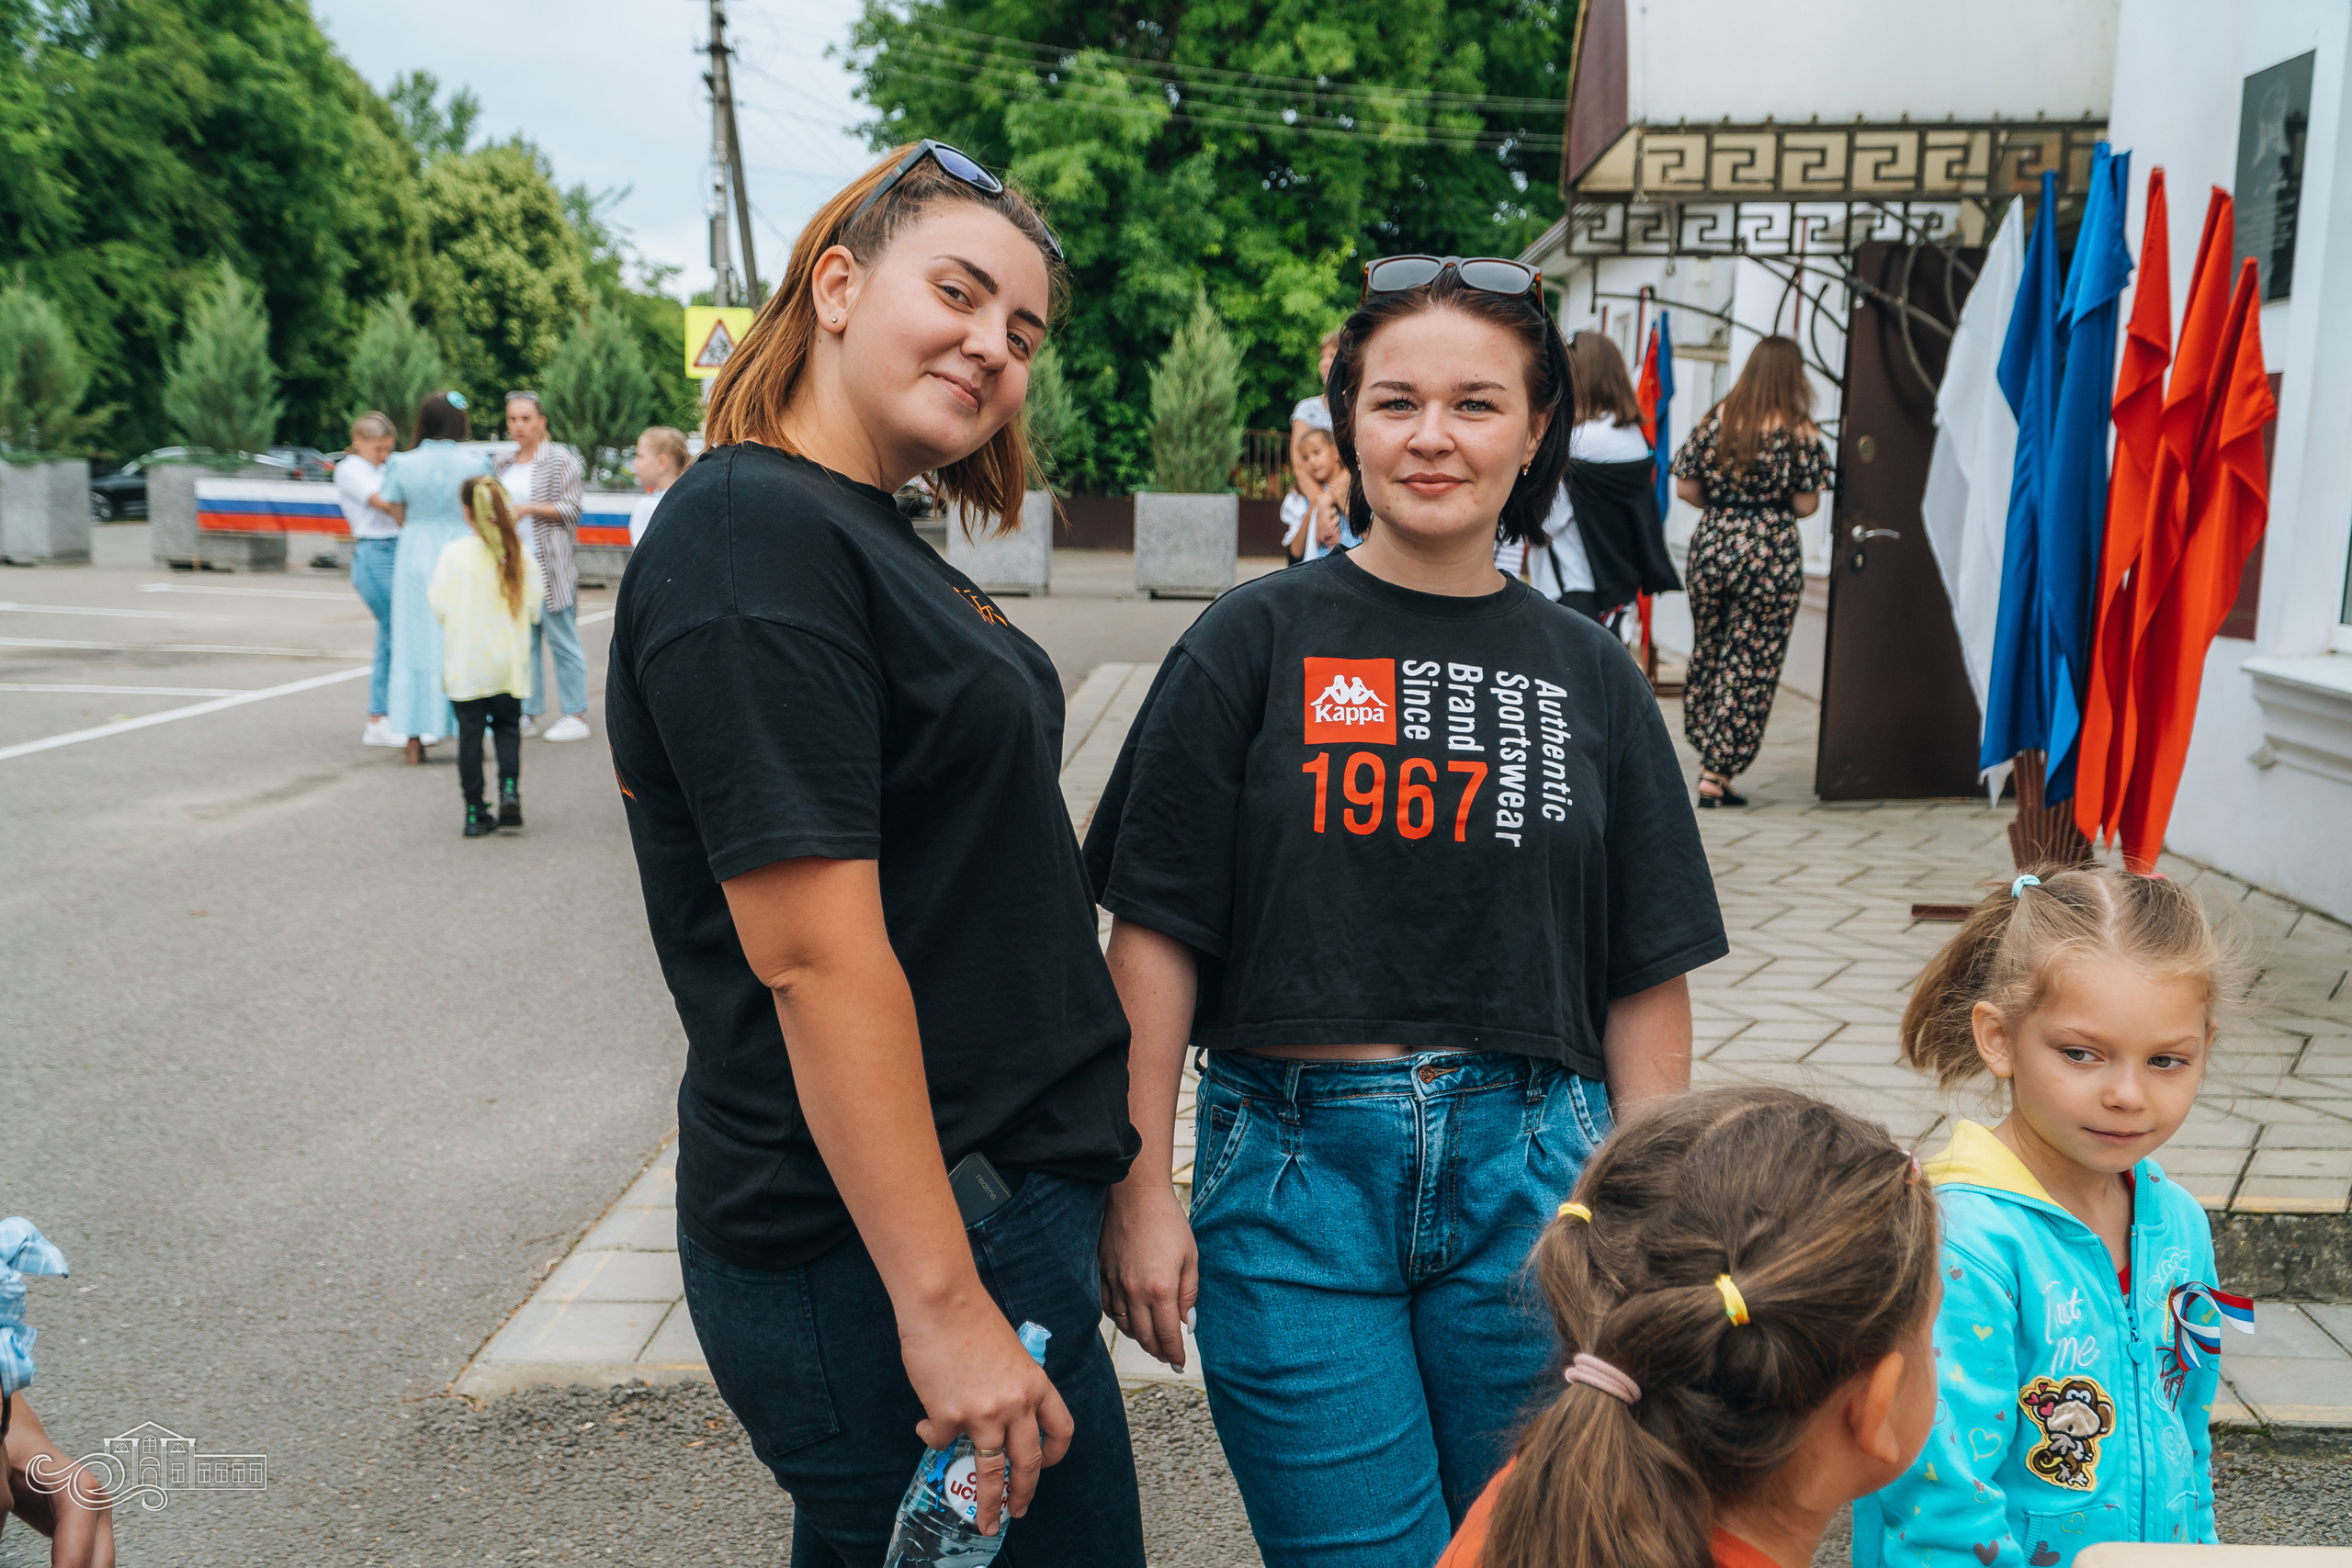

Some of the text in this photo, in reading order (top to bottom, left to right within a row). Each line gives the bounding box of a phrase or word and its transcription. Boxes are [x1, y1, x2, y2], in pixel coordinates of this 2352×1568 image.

[1315, 704, 1385, 726] Kappa
[1402, 660, 1441, 740] Since
[1448, 661, 1485, 751] Brand
[1490, 671, 1531, 848] Sportswear
[1534, 678, 1572, 822] Authentic
[1302, 751, 1488, 842] 1967
[975, 1174, 997, 1201] realme
[2051, 1335, 2100, 1378] me
